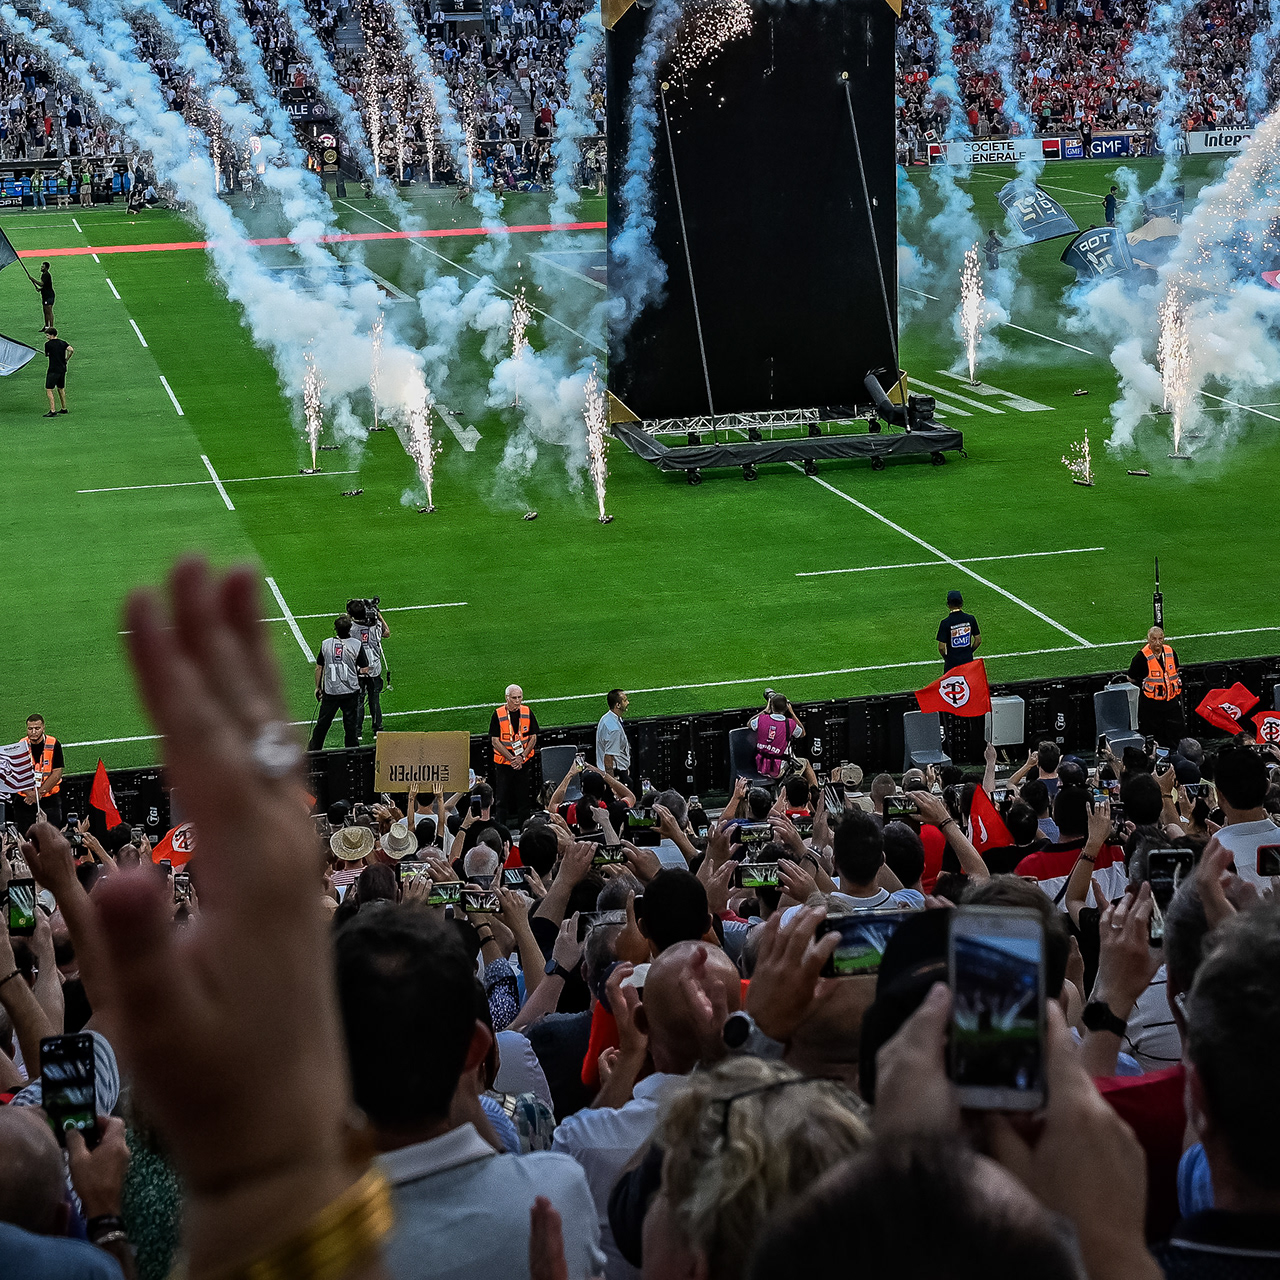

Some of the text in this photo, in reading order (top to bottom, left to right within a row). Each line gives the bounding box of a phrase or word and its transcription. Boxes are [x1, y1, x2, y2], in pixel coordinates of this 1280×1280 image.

[1092, 140, 1122, 154] GMF
[953, 636, 969, 646] GMF
[389, 764, 439, 782] HOPPER
[440, 764, 450, 782] MTB
[150, 806, 158, 821] TGI
